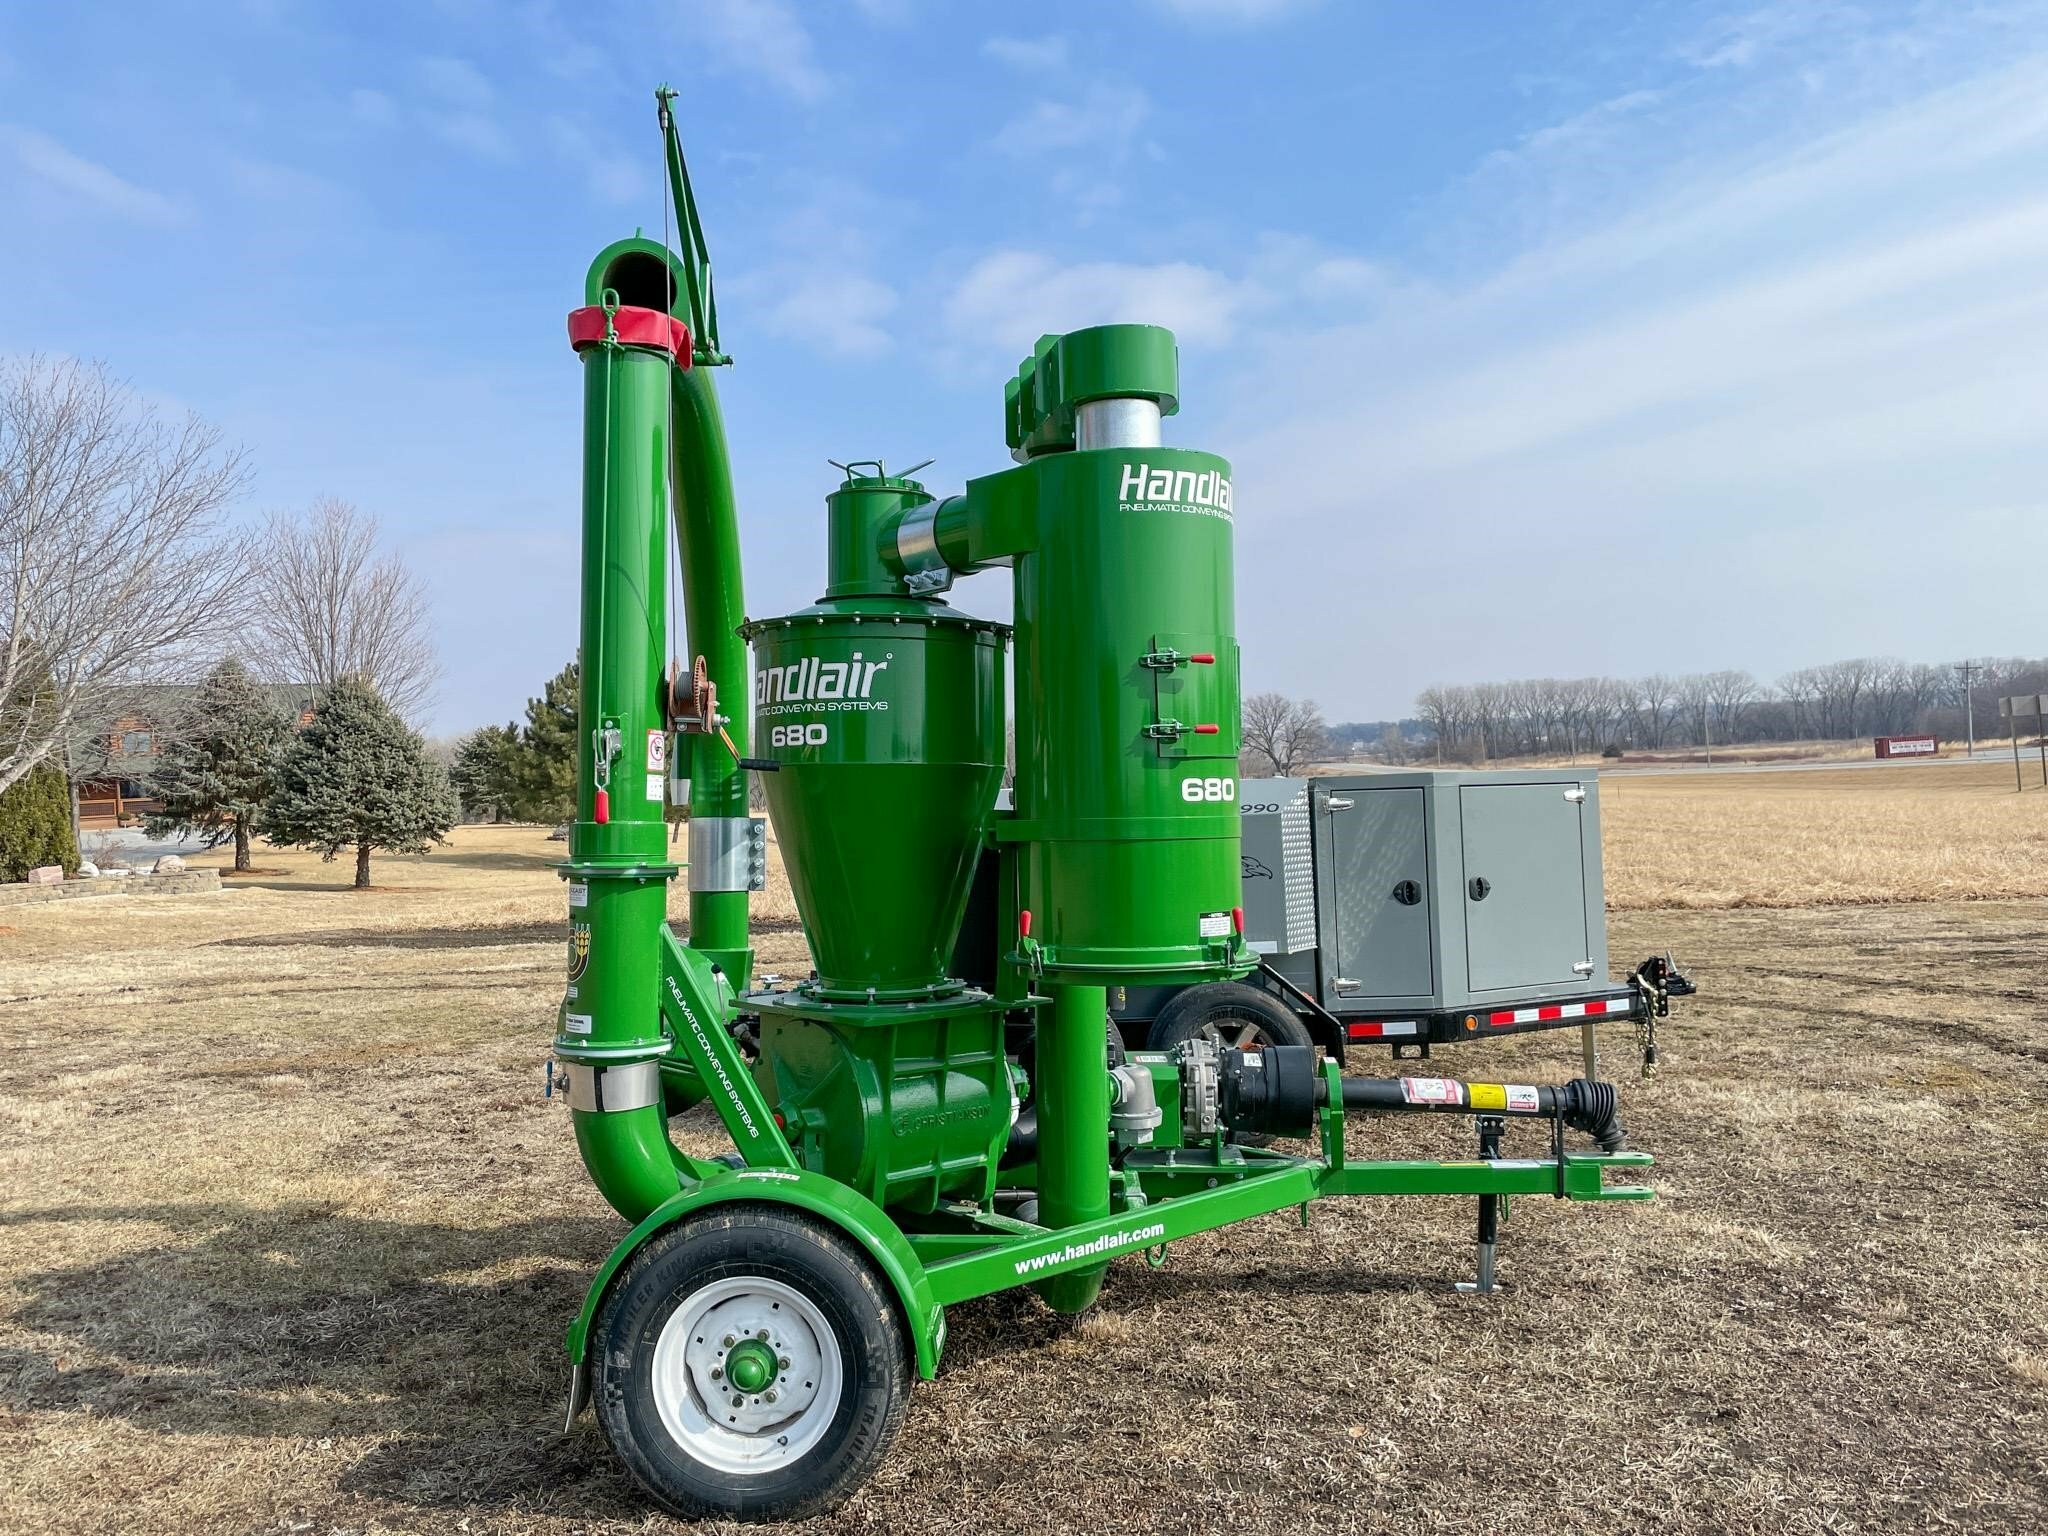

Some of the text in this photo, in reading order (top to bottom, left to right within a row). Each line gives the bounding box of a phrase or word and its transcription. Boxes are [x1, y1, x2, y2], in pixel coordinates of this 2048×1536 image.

[1119, 503, 1180, 512] PNEUMATIC
[1181, 505, 1225, 518] CONVEYING
[771, 703, 825, 715] CONVEYING
[828, 701, 888, 711] SYSTEMS
[771, 723, 828, 747] 680
[1181, 778, 1235, 802] 680
[1240, 803, 1280, 814] 990
[666, 976, 760, 1139] PNEUMATIC CONVEYING SYSTEMS
[1015, 1223, 1165, 1275] www.handlair.com
